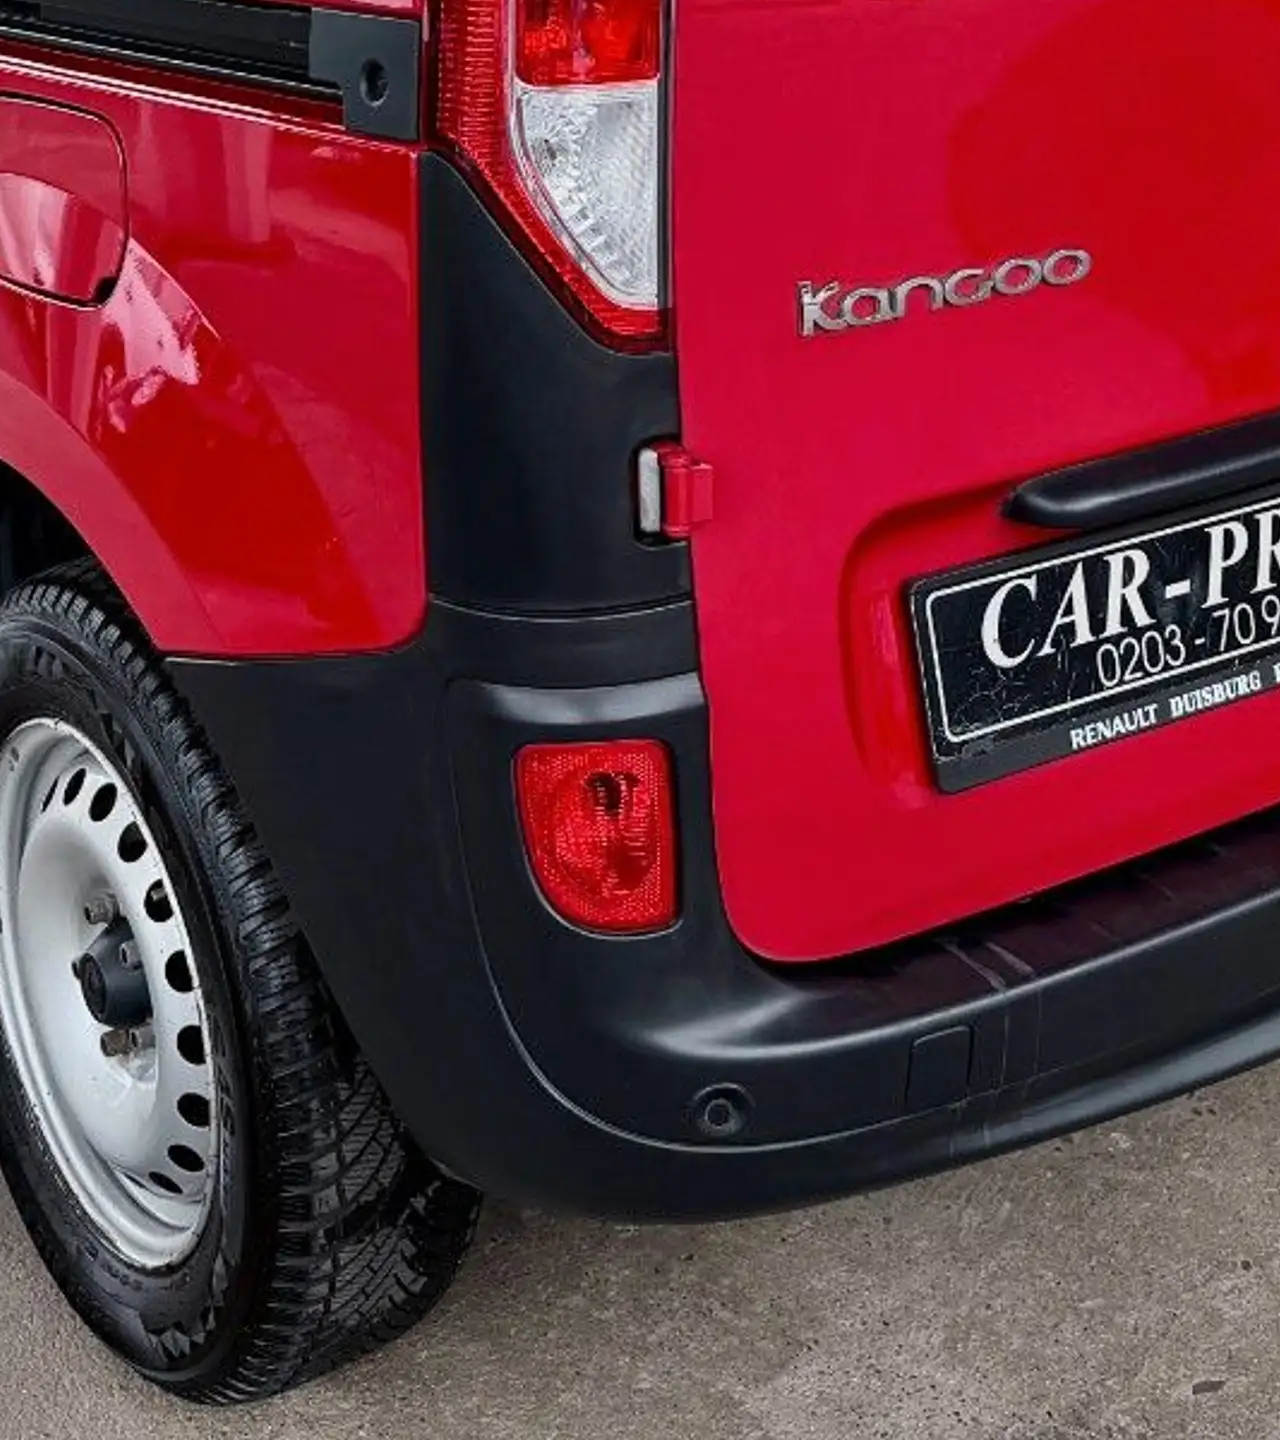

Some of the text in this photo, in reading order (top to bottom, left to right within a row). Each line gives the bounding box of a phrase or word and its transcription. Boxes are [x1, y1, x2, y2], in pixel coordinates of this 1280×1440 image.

[797, 248, 1093, 336] Kangoo
[1096, 624, 1187, 689] 0203
[1213, 602, 1255, 651] 70
[1070, 702, 1158, 750] RENAULT
[1168, 670, 1261, 717] DUISBURG
